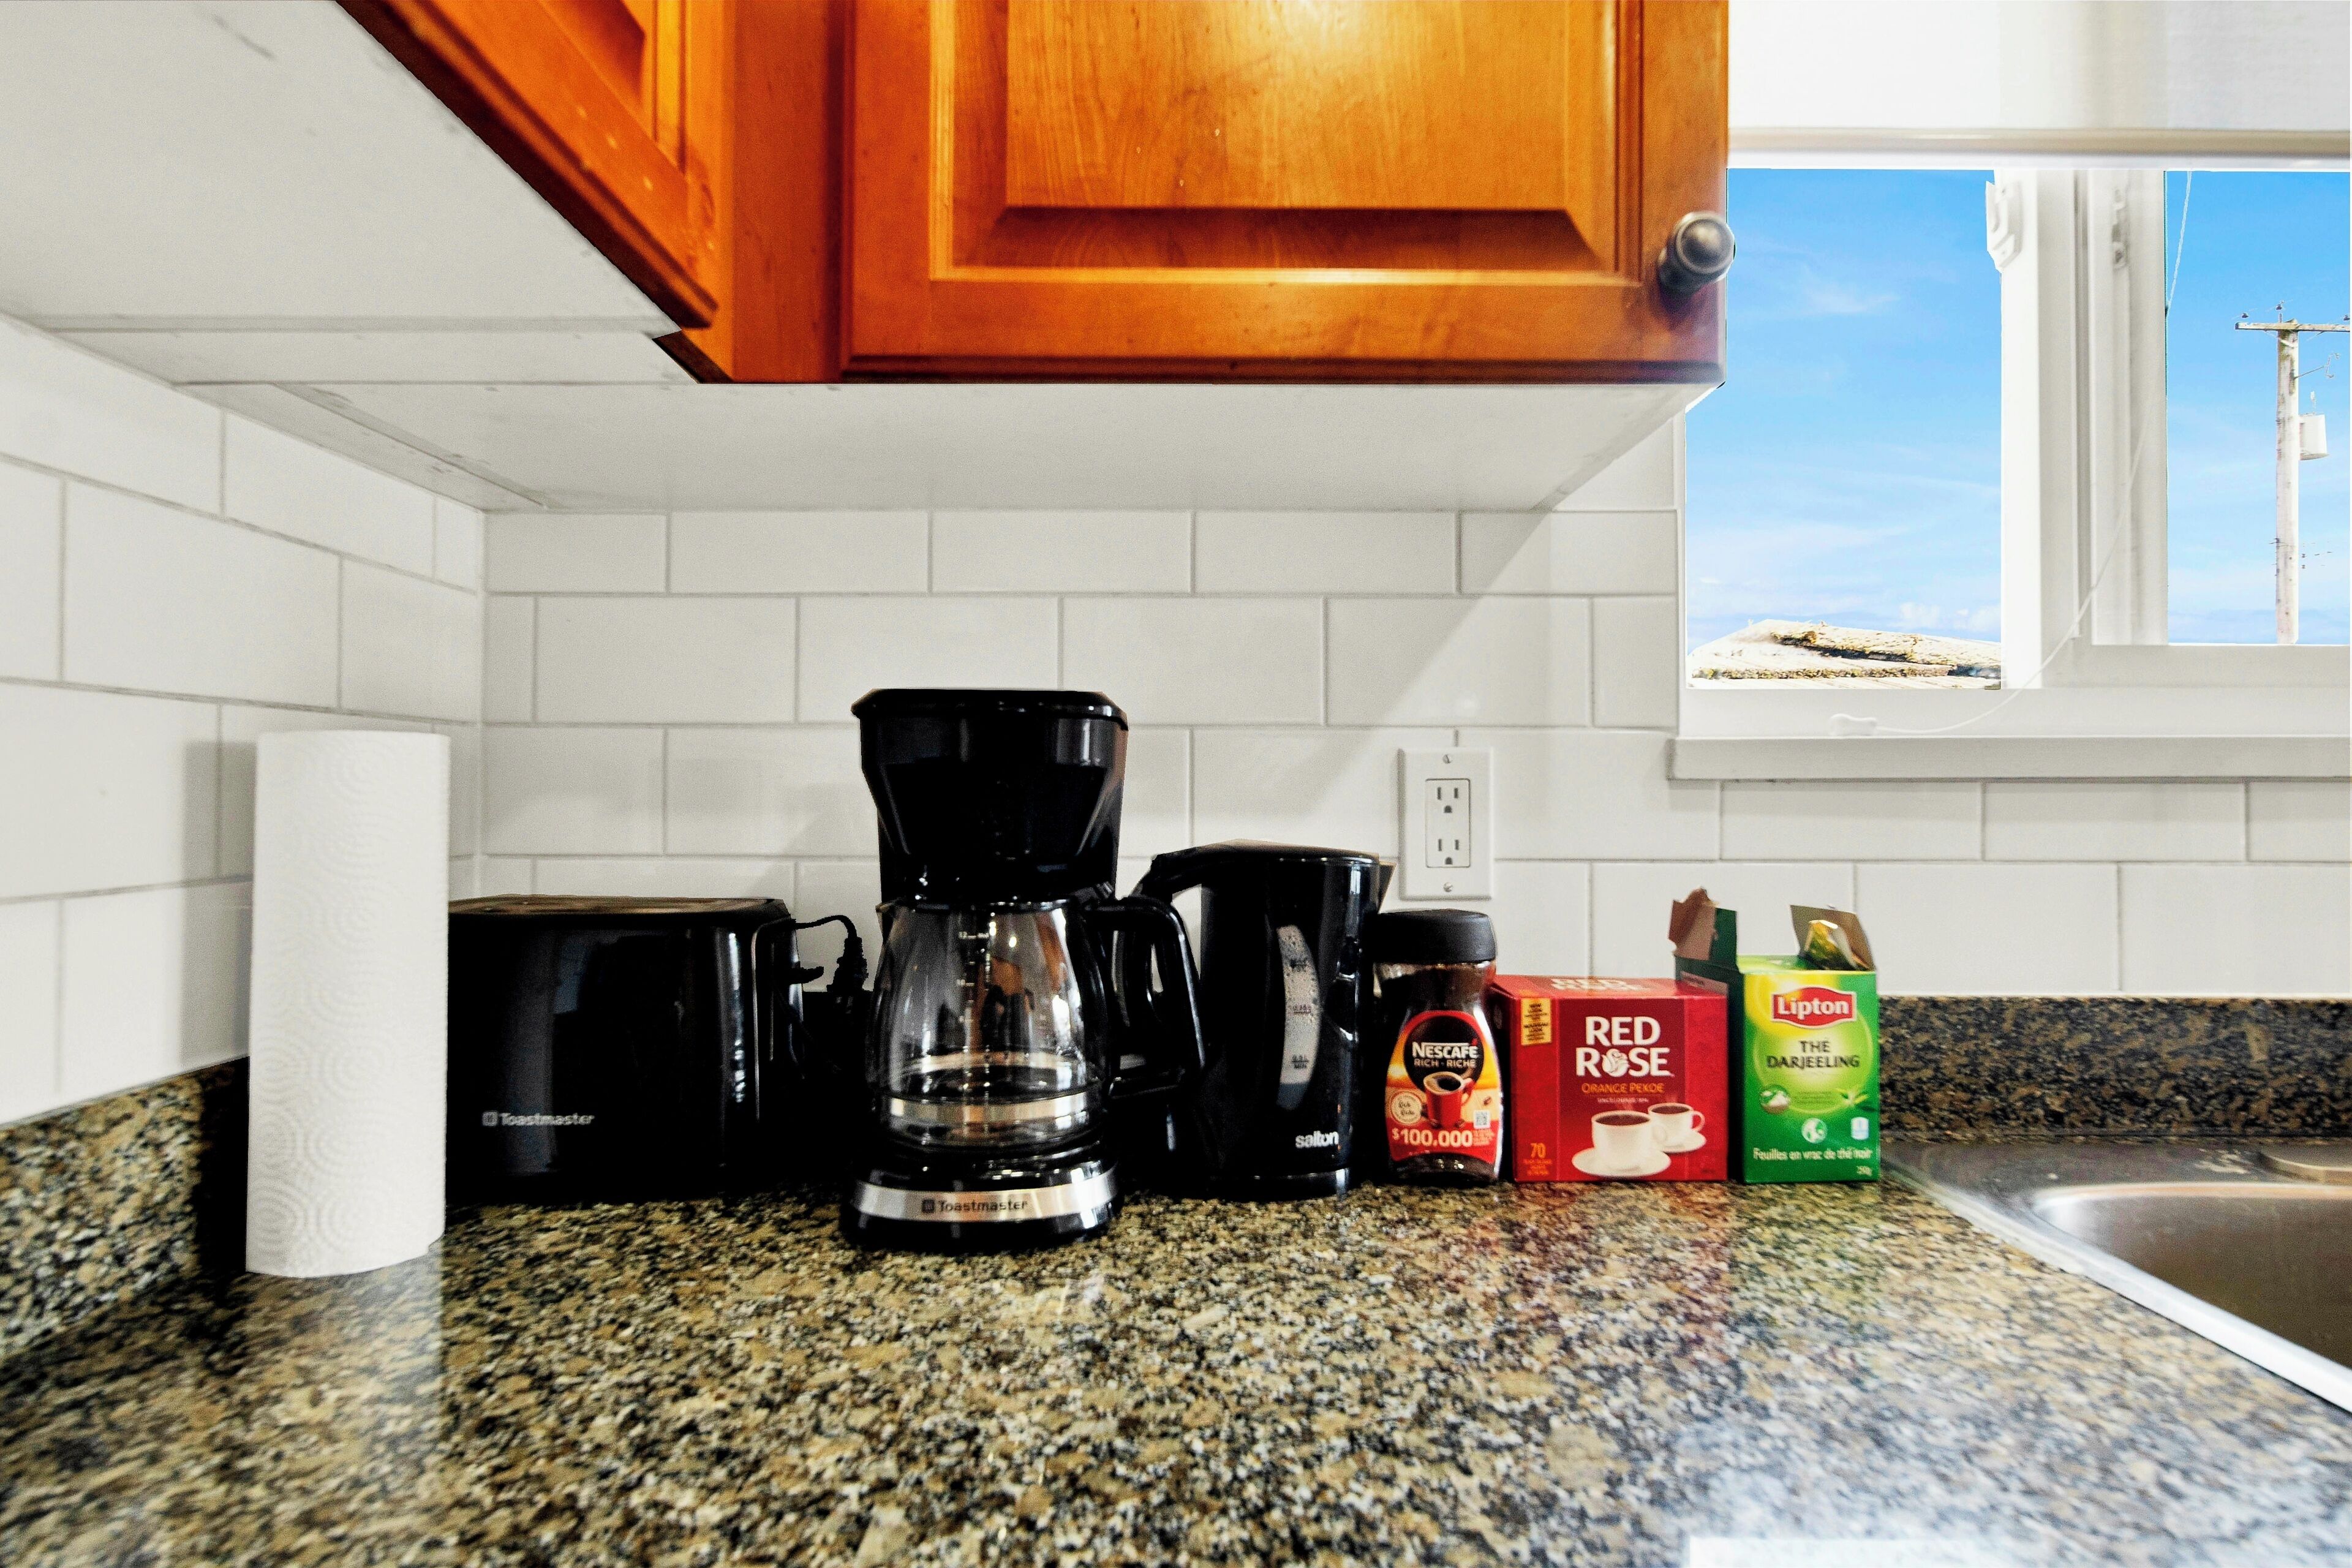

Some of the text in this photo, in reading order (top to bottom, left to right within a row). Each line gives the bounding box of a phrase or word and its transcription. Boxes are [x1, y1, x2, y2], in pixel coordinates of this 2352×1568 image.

[1777, 996, 1849, 1020] Lipton
[1585, 1016, 1661, 1046] RED
[1414, 1058, 1476, 1068] RICH RICHE
[1575, 1047, 1671, 1078] ROSE
[1766, 1055, 1860, 1069] DARJEELING
[1581, 1082, 1665, 1094] ORANGE PEKOE
[499, 1112, 595, 1126] Toastmaster
[1295, 1130, 1339, 1148] salton
[1531, 1143, 1546, 1158] 70
[1753, 1147, 1789, 1160] Feuilles
[1789, 1151, 1802, 1160] en
[1803, 1150, 1823, 1159] vrac
[1823, 1148, 1836, 1159] de
[938, 1199, 1028, 1212] Toastmaster
